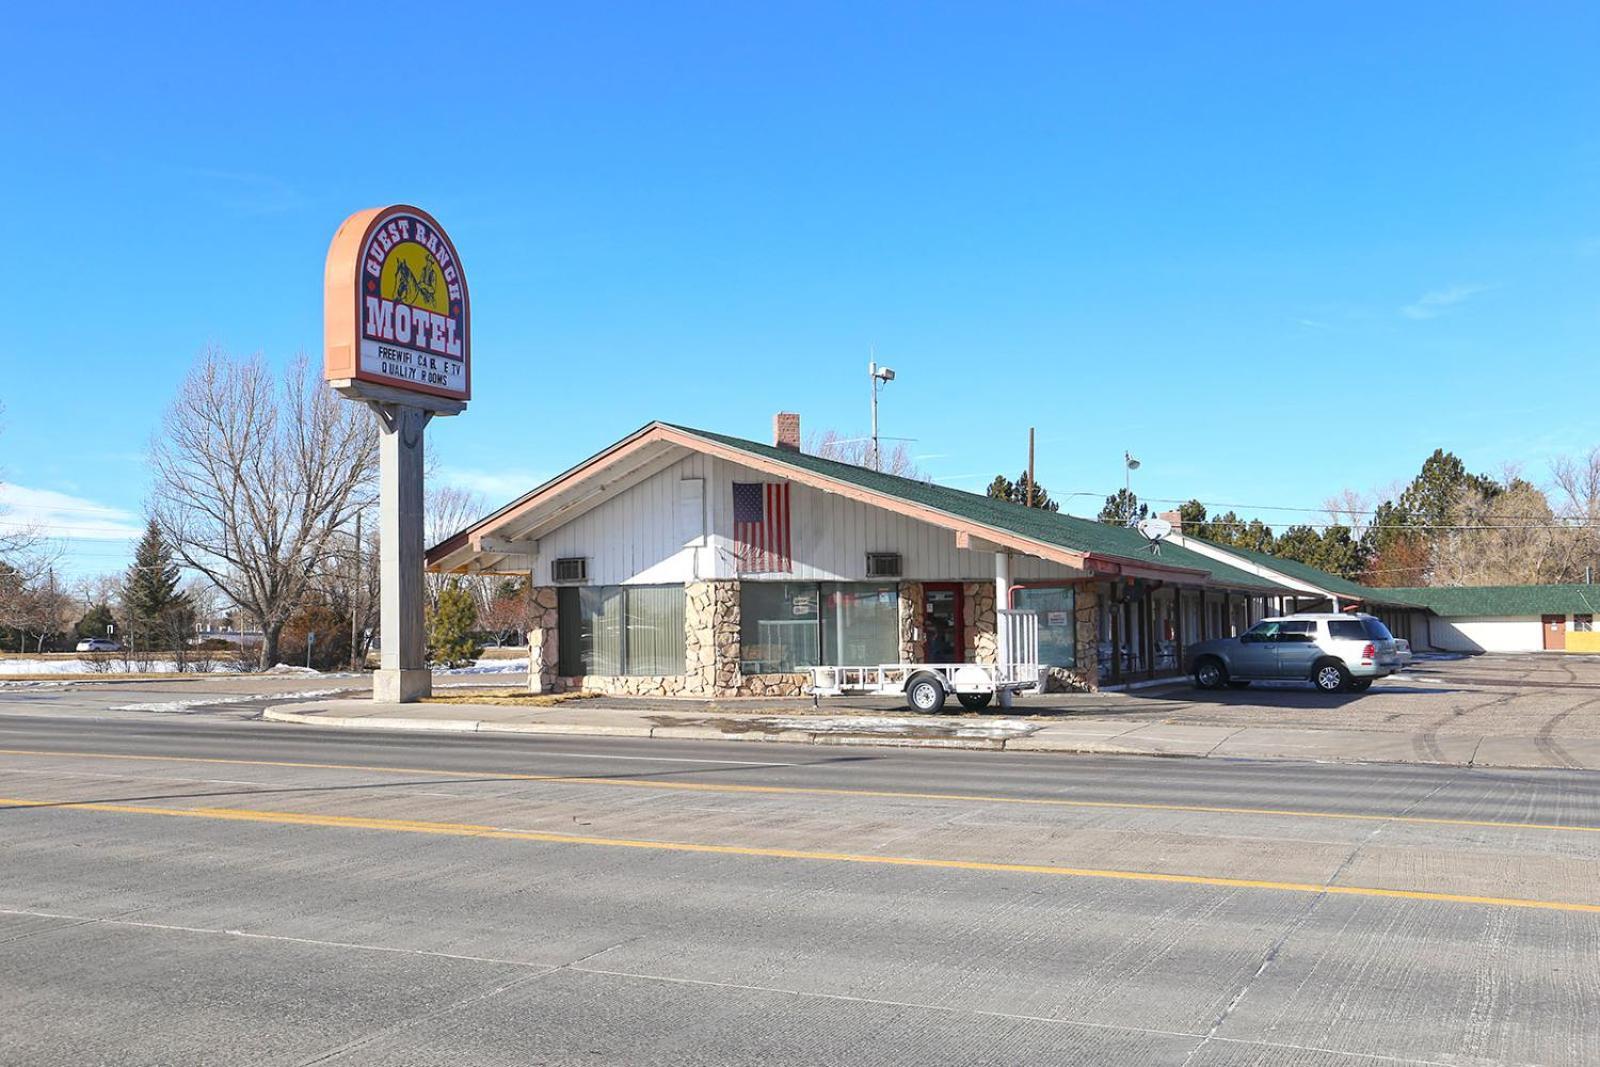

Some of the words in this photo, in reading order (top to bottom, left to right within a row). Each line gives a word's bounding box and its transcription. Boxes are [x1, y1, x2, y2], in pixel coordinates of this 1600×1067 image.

[366, 219, 410, 278] GUEST
[415, 222, 461, 301] RANCH
[366, 296, 461, 357] MOTEL
[421, 370, 448, 386] ROOMS
[451, 363, 461, 376] TV
